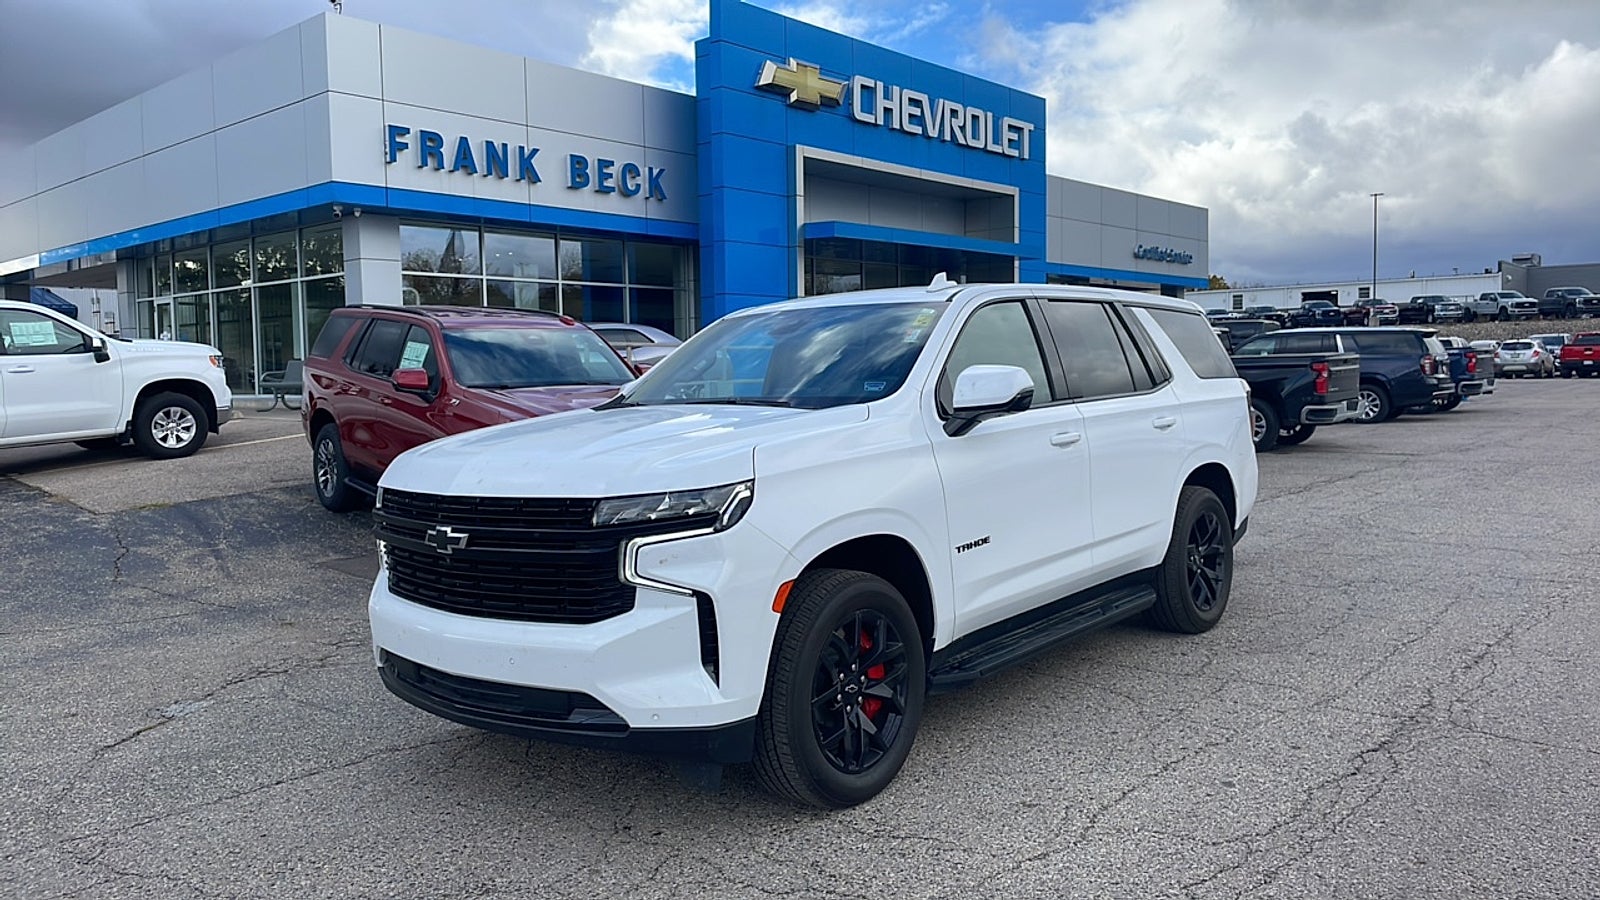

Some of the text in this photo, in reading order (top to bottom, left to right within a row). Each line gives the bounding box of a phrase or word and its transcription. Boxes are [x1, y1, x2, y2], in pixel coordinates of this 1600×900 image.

[852, 75, 1034, 159] CHEVROLET
[385, 123, 668, 201] FRANK BECK
[955, 535, 991, 554] TAHOE
